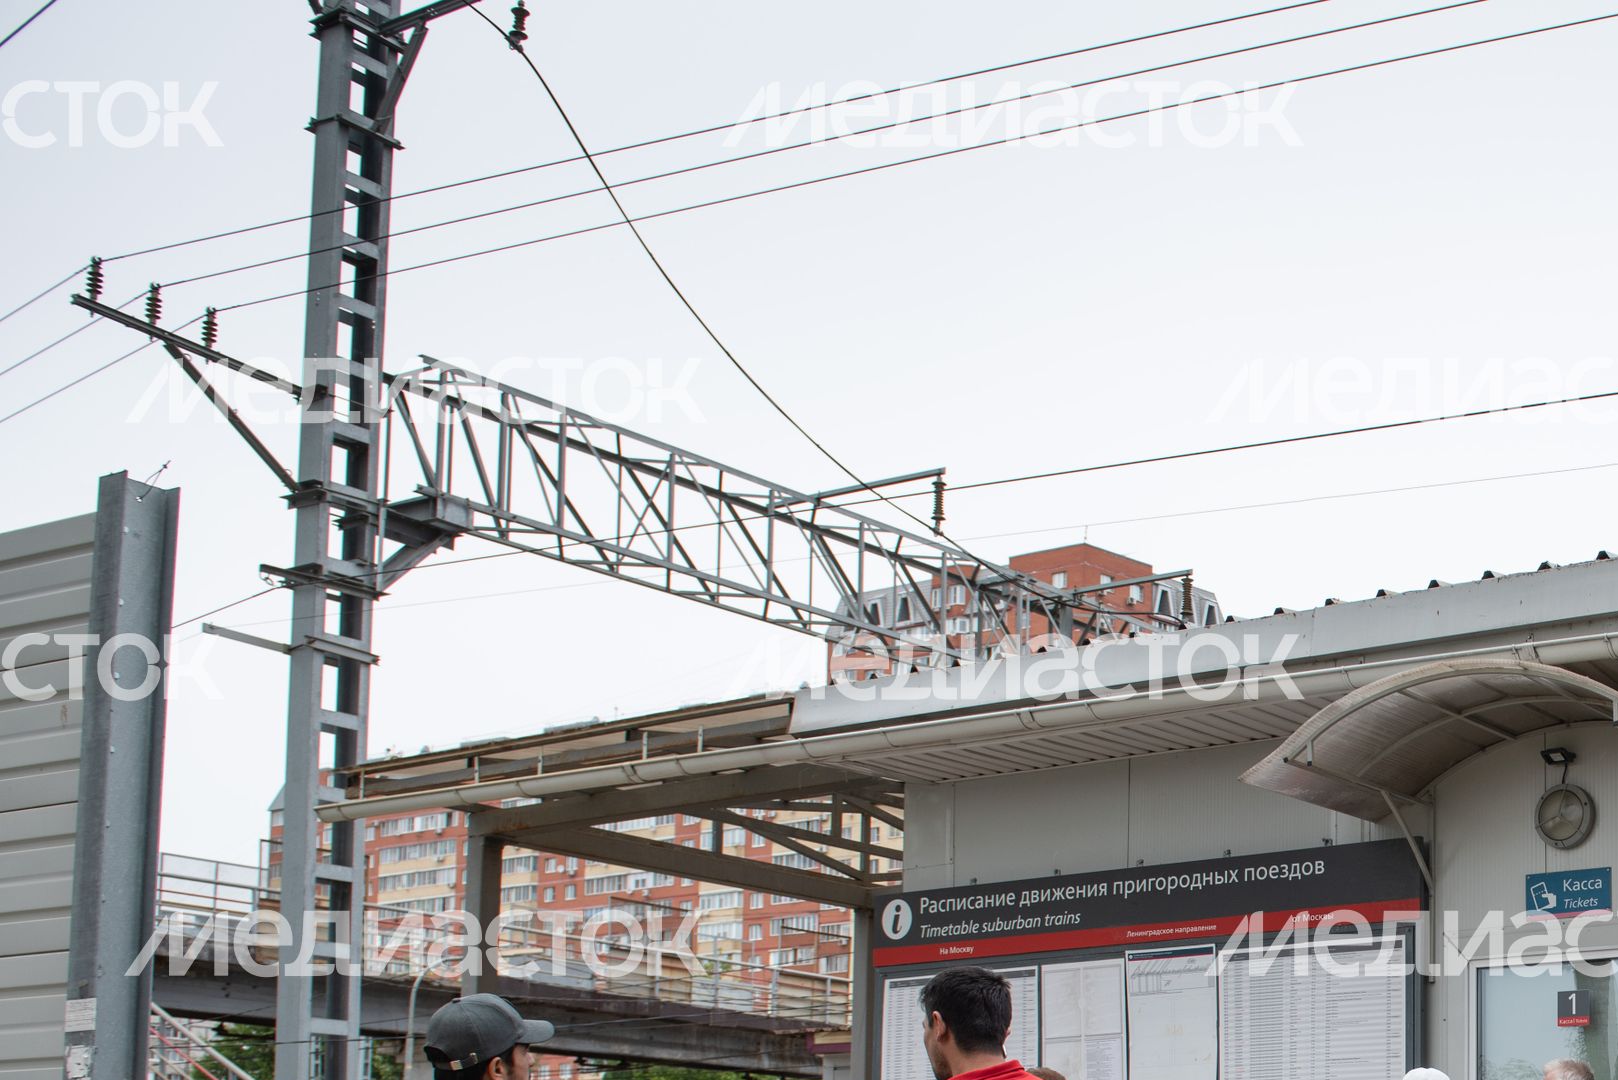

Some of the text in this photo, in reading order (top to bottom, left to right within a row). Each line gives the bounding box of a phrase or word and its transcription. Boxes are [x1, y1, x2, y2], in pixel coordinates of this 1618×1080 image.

[919, 859, 1325, 915] Расписание движения пригородных поездов
[1563, 878, 1602, 892] Касса
[1563, 897, 1598, 909] Tickets
[919, 911, 1081, 939] Timetable suburban trains
[1127, 924, 1217, 938] Ленинградское направление
[940, 945, 974, 955] На Москву
[1568, 993, 1576, 1015] 1
